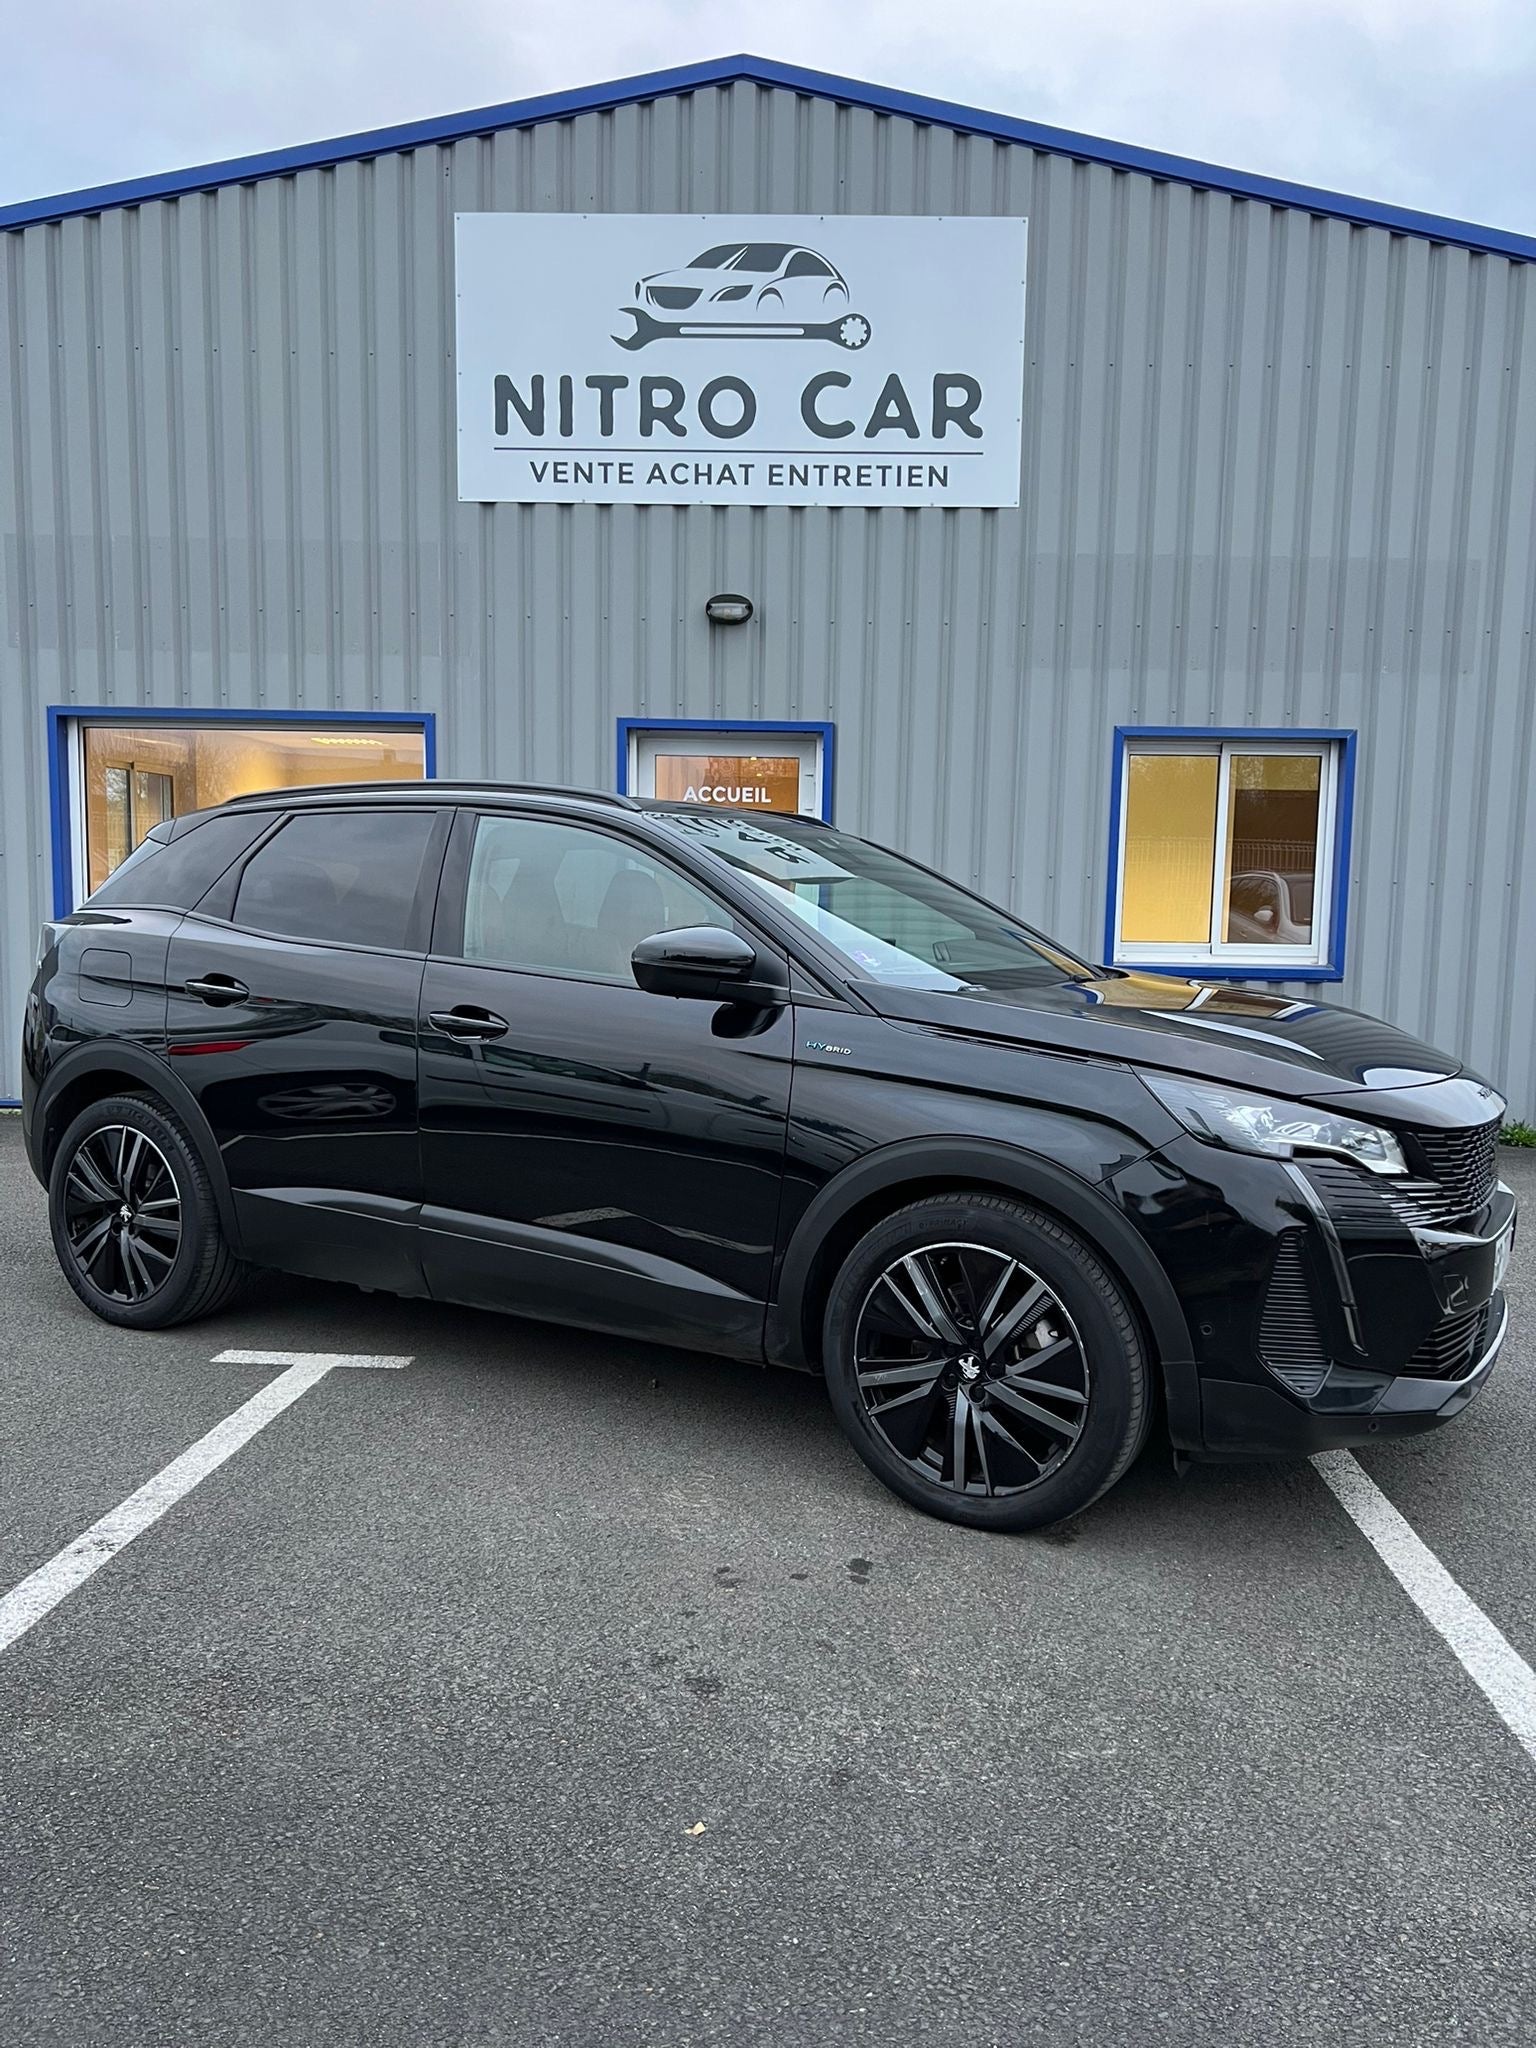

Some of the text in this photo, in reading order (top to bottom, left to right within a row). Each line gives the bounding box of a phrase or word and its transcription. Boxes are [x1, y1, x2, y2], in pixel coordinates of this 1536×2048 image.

[495, 371, 984, 439] NITRO CAR
[529, 461, 949, 488] VENTE ACHAT ENTRETIEN
[683, 786, 772, 803] ACCUEIL
[806, 1040, 852, 1055] HYBRID
